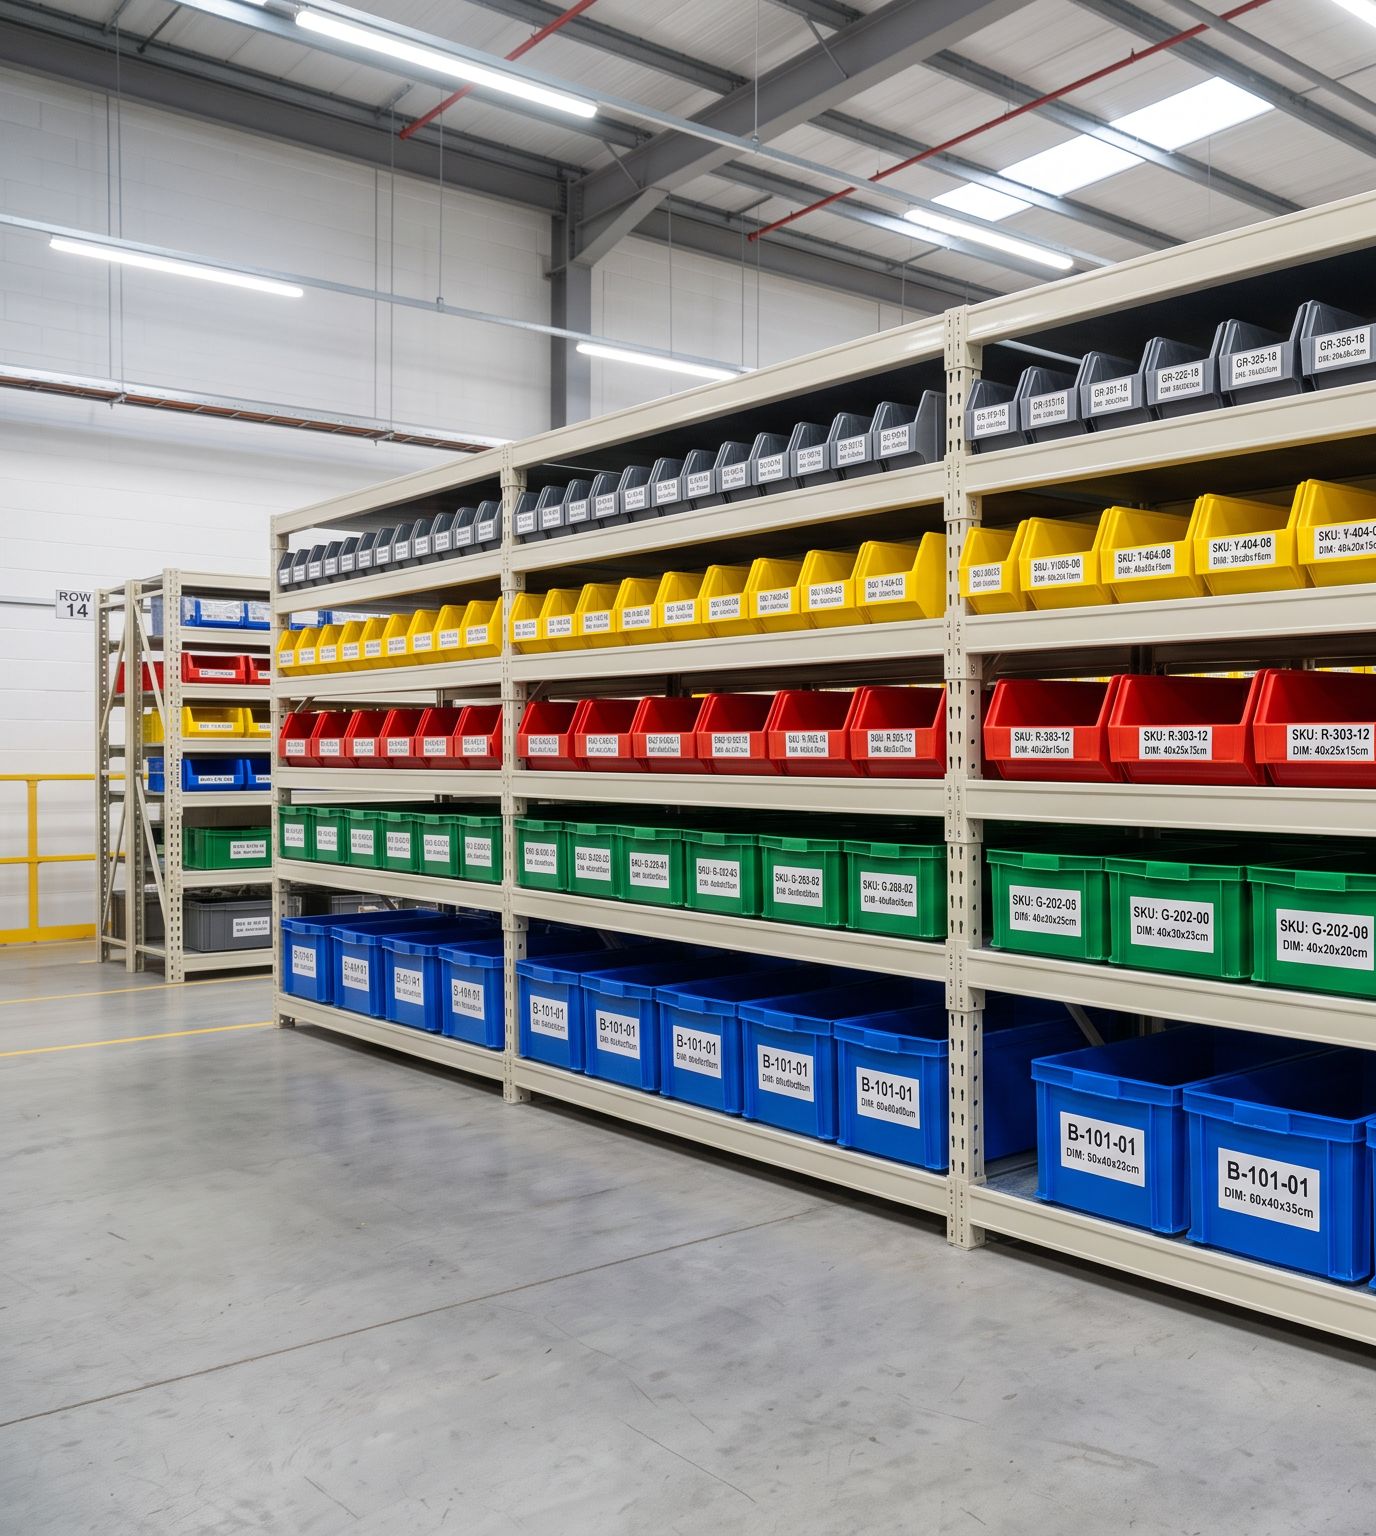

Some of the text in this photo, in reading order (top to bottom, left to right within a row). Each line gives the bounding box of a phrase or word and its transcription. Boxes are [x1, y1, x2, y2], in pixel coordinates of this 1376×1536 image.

[1318, 530, 1340, 542] SKU:
[1212, 542, 1232, 552] SKU:
[60, 592, 91, 602] ROW
[67, 604, 88, 617] 14
[1144, 730, 1166, 741] SKU:
[1292, 728, 1370, 740] SKU: R-303-12
[1144, 746, 1161, 754] DIM:
[1293, 746, 1368, 756] DIM: 40x25x15cm
[1012, 894, 1034, 906] SKU:
[1134, 906, 1210, 924] SKU: G-202-00
[1136, 925, 1154, 936] DIM:
[1280, 919, 1308, 934] SKU:
[1283, 940, 1368, 958] DIM: 40x20x20cm
[532, 1002, 564, 1020] B-101-01
[600, 1018, 636, 1038] B-101-01
[676, 1034, 716, 1056] B-101-01
[763, 1054, 808, 1078] B-101-01
[862, 1076, 912, 1102] B-101-01
[1068, 1122, 1135, 1156] B-101-01
[1066, 1148, 1085, 1160] DIM:
[1228, 1160, 1308, 1198] B-101-01
[1224, 1187, 1314, 1218] DIM: 60x40x35cm
